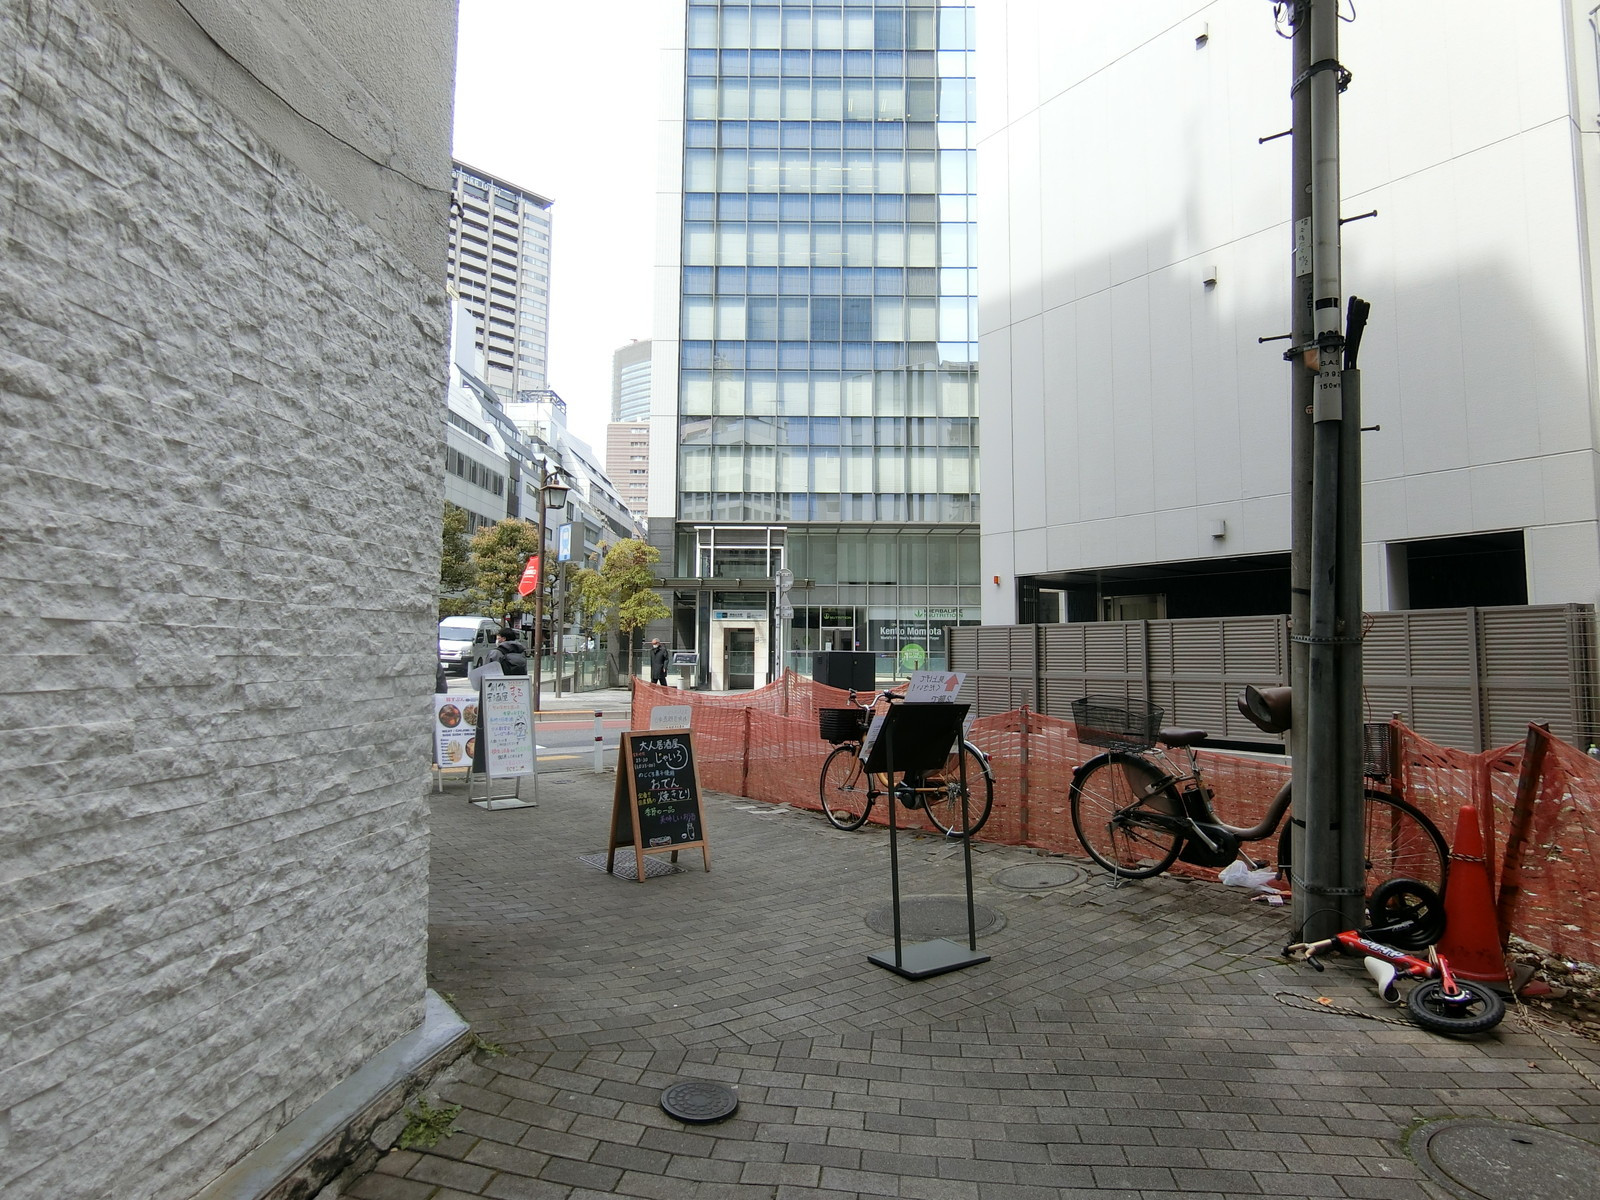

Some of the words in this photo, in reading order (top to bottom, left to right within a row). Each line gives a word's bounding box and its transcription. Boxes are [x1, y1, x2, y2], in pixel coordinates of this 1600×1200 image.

[880, 626, 905, 635] Kento
[907, 627, 942, 636] Momota
[640, 738, 680, 751] 大人居酒屋
[651, 778, 680, 789] おでん
[658, 788, 690, 803] 焼きとり
[645, 805, 676, 817] 季節の一品
